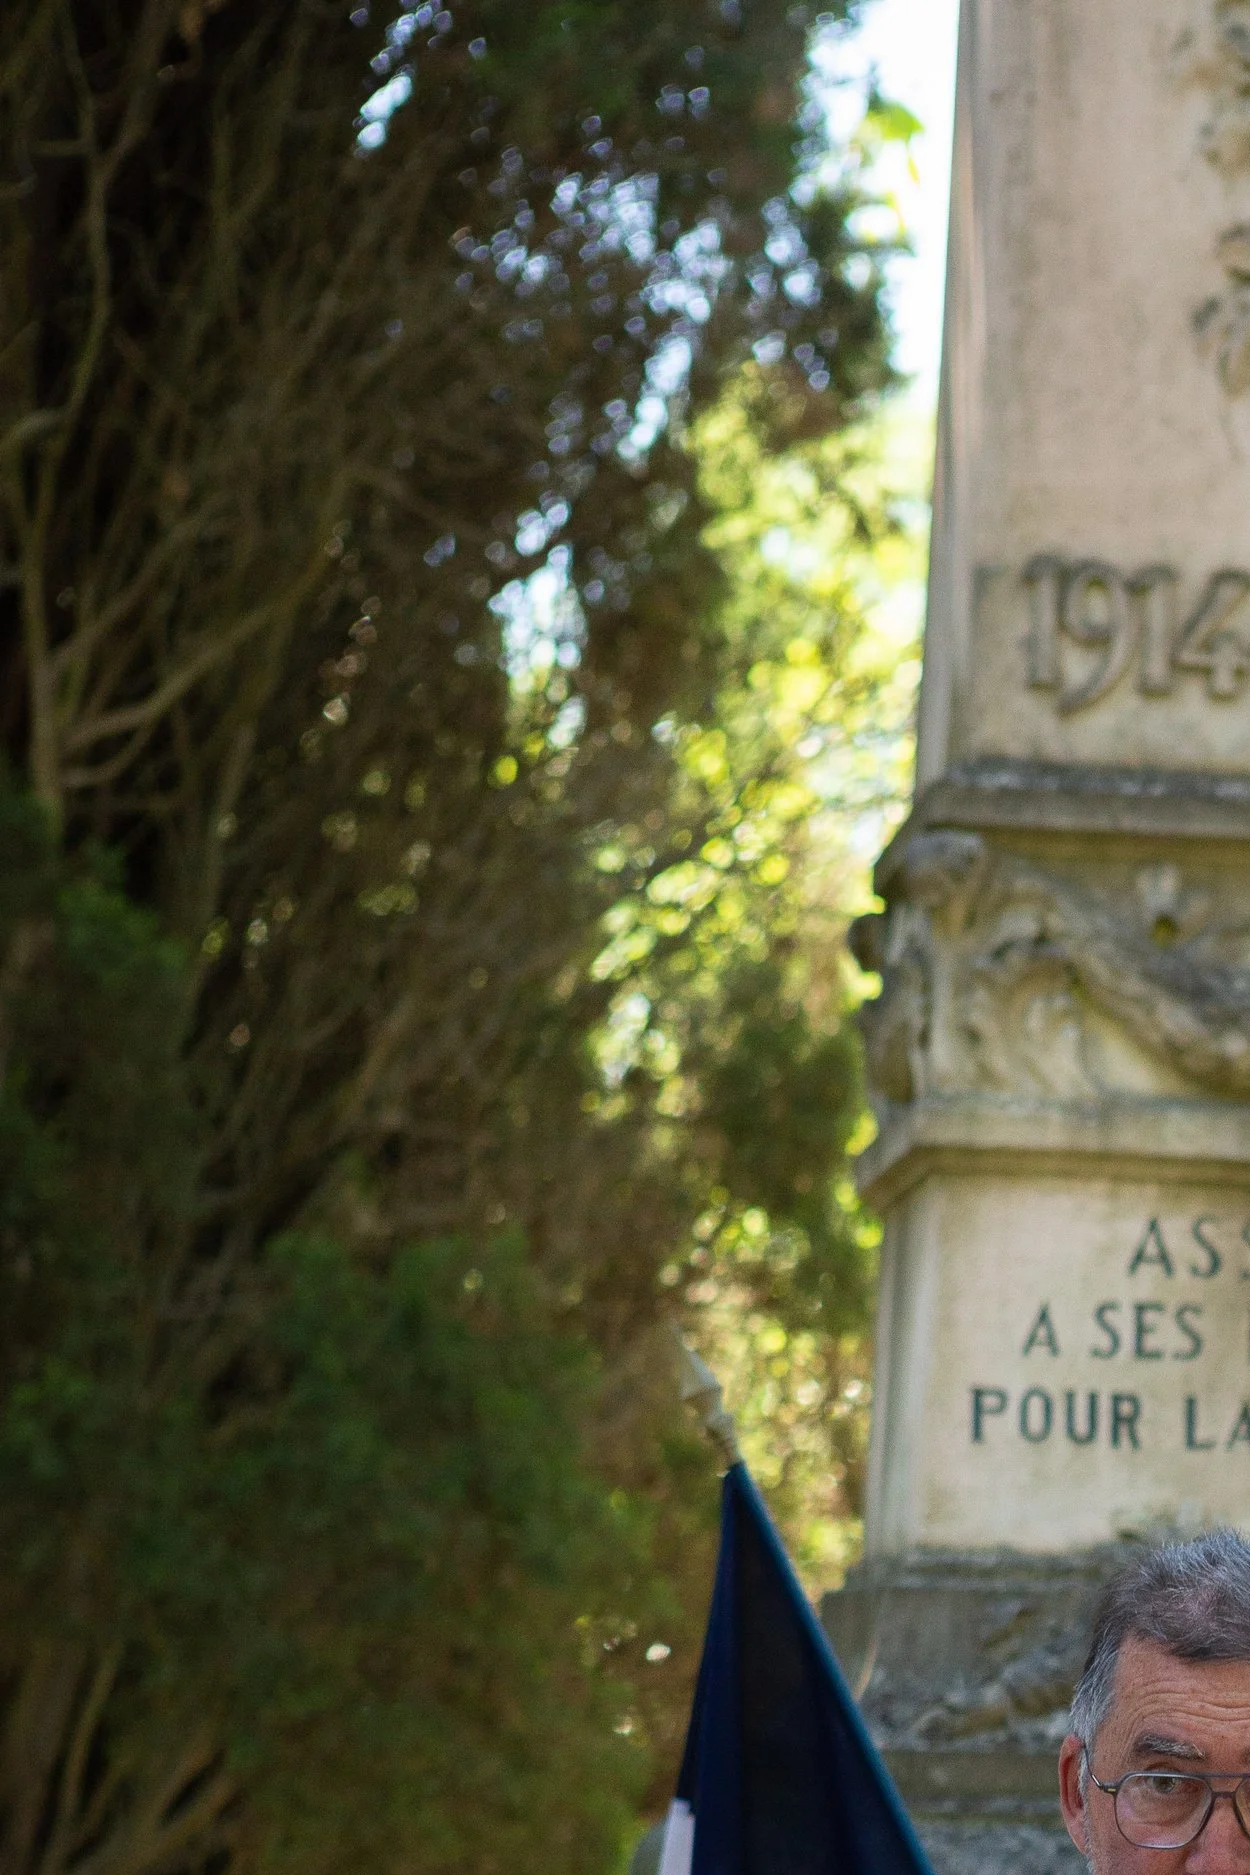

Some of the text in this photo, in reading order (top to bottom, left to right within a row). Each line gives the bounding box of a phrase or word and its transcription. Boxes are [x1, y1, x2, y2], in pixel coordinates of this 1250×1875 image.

[1021, 1301, 1061, 1359] A
[1090, 1301, 1203, 1361] SES
[969, 1385, 1142, 1451] POUR
